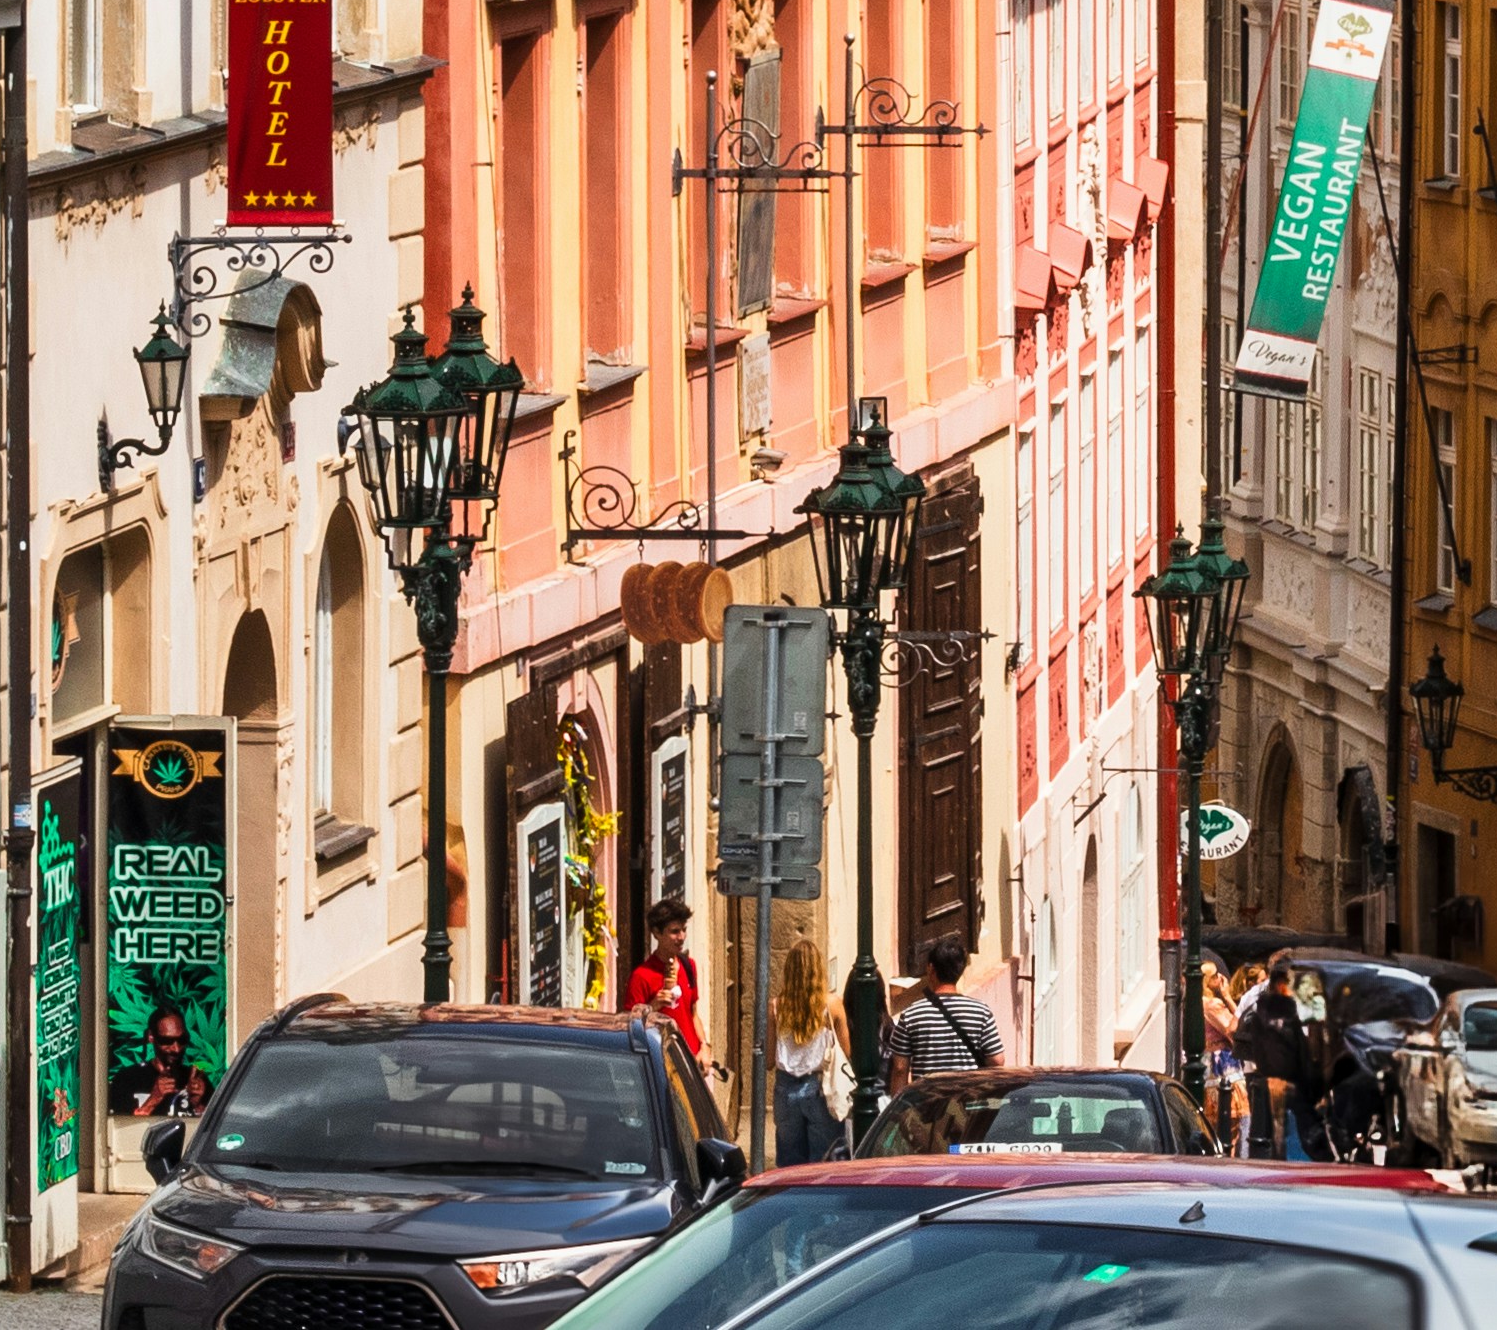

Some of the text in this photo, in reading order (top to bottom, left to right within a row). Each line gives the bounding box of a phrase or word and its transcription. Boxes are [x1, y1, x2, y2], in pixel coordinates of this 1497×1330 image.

[264, 20, 292, 167] HOTEL
[1270, 140, 1327, 263] VEGAN
[1301, 117, 1365, 301] RESTAURANT
[43, 860, 76, 913] THC
[114, 844, 222, 881] REAL
[110, 885, 224, 923] WEED
[115, 928, 220, 964] HERE
